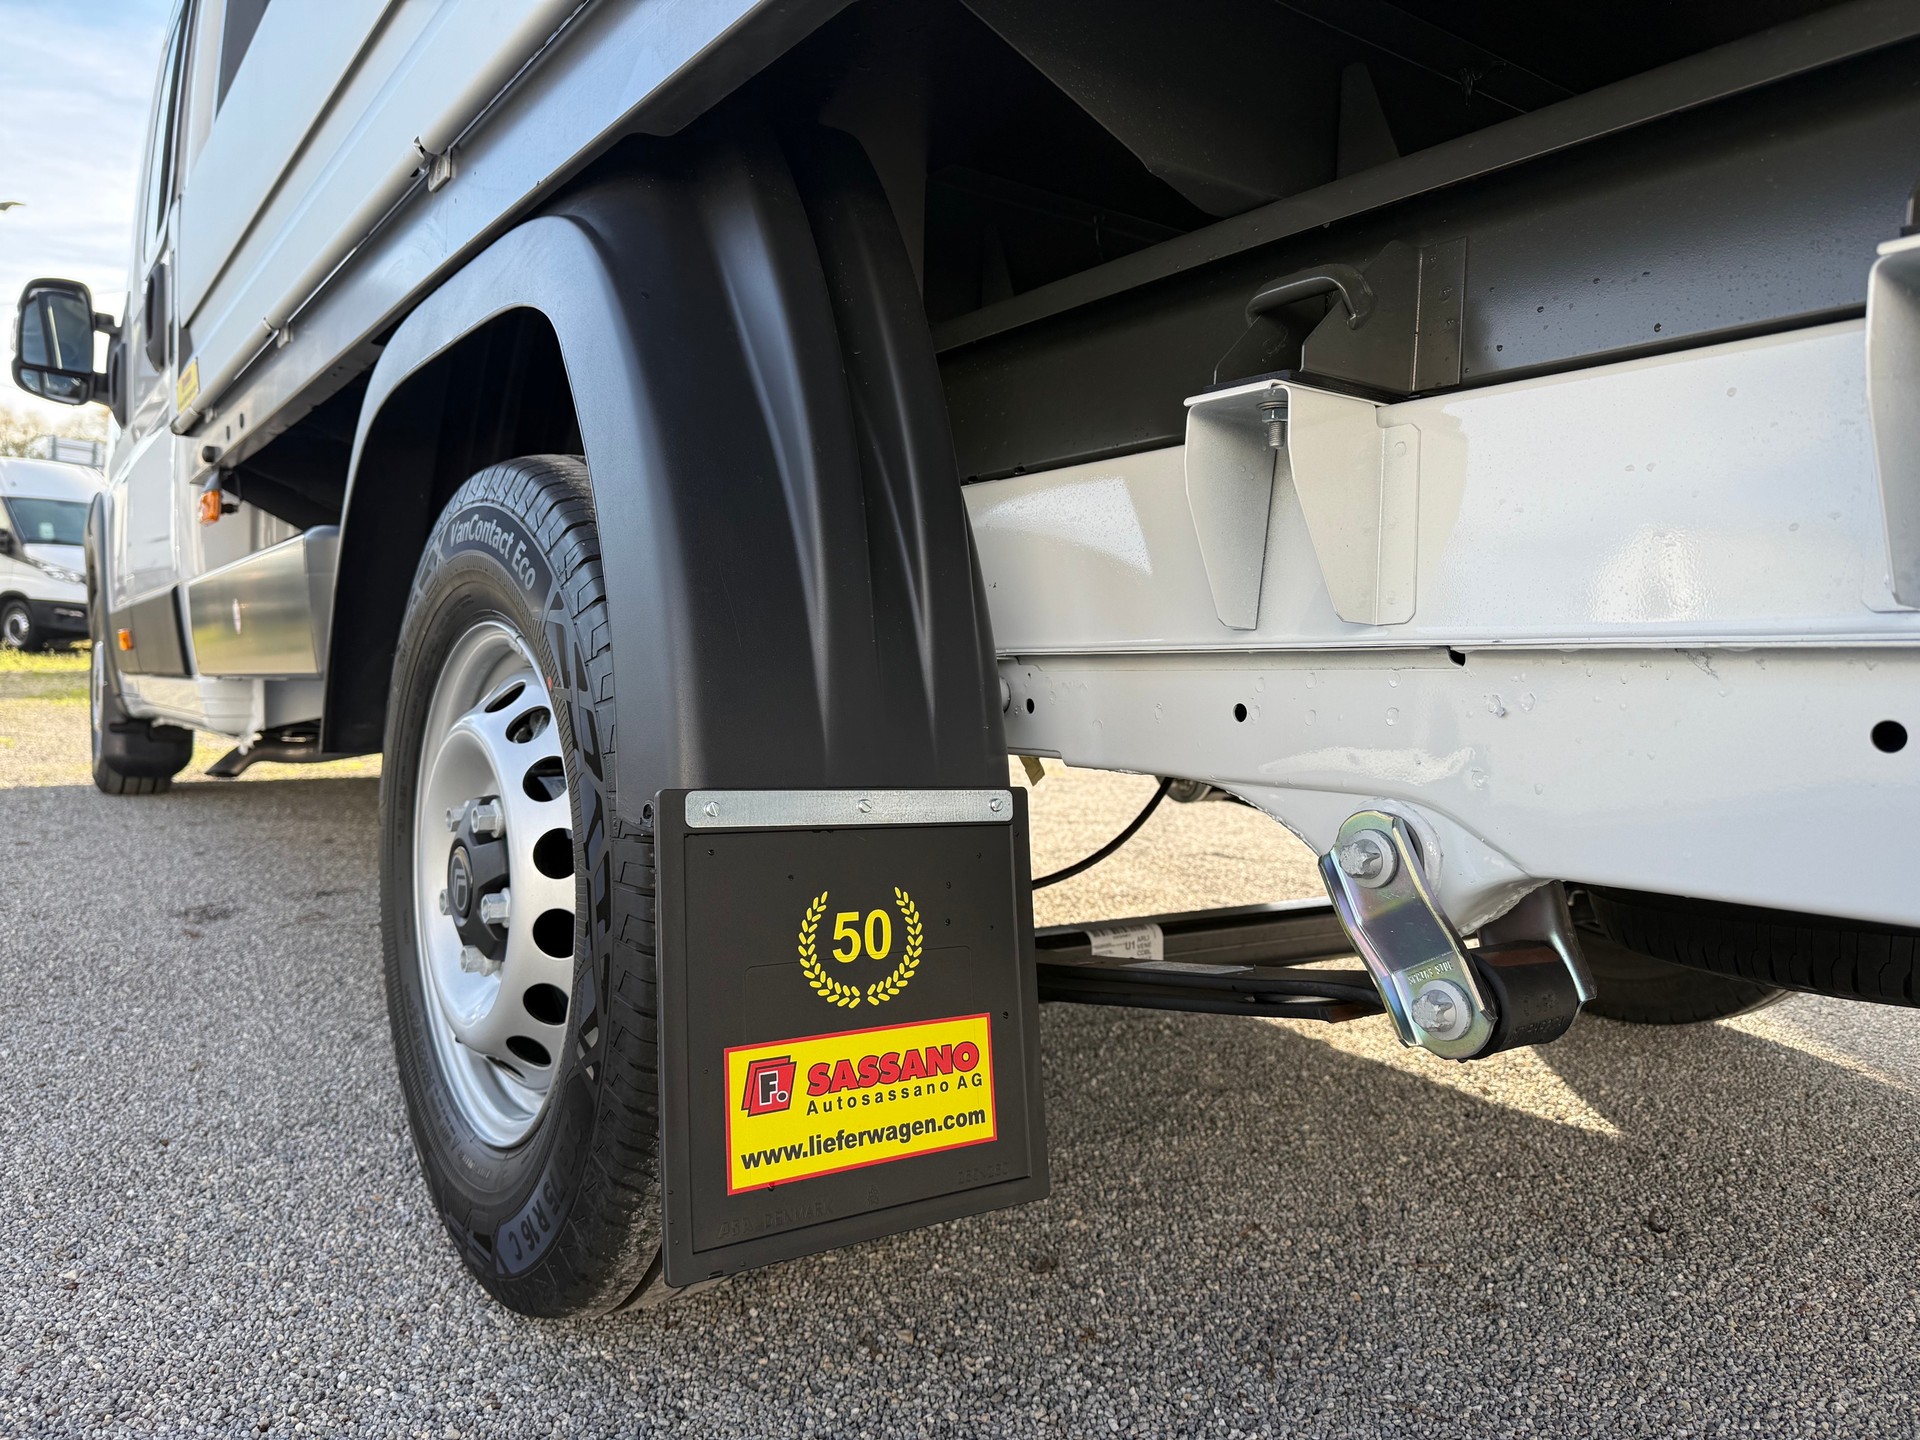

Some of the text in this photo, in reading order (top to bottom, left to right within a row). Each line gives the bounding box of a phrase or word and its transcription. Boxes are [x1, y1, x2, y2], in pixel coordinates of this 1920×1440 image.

[450, 513, 536, 591] VanContact Eco
[832, 908, 892, 963] 50
[806, 1041, 980, 1097] SASSANO
[806, 1072, 983, 1116] Autosassano AG
[741, 1108, 986, 1170] www.lieferwagen.com
[508, 1230, 523, 1261] C
